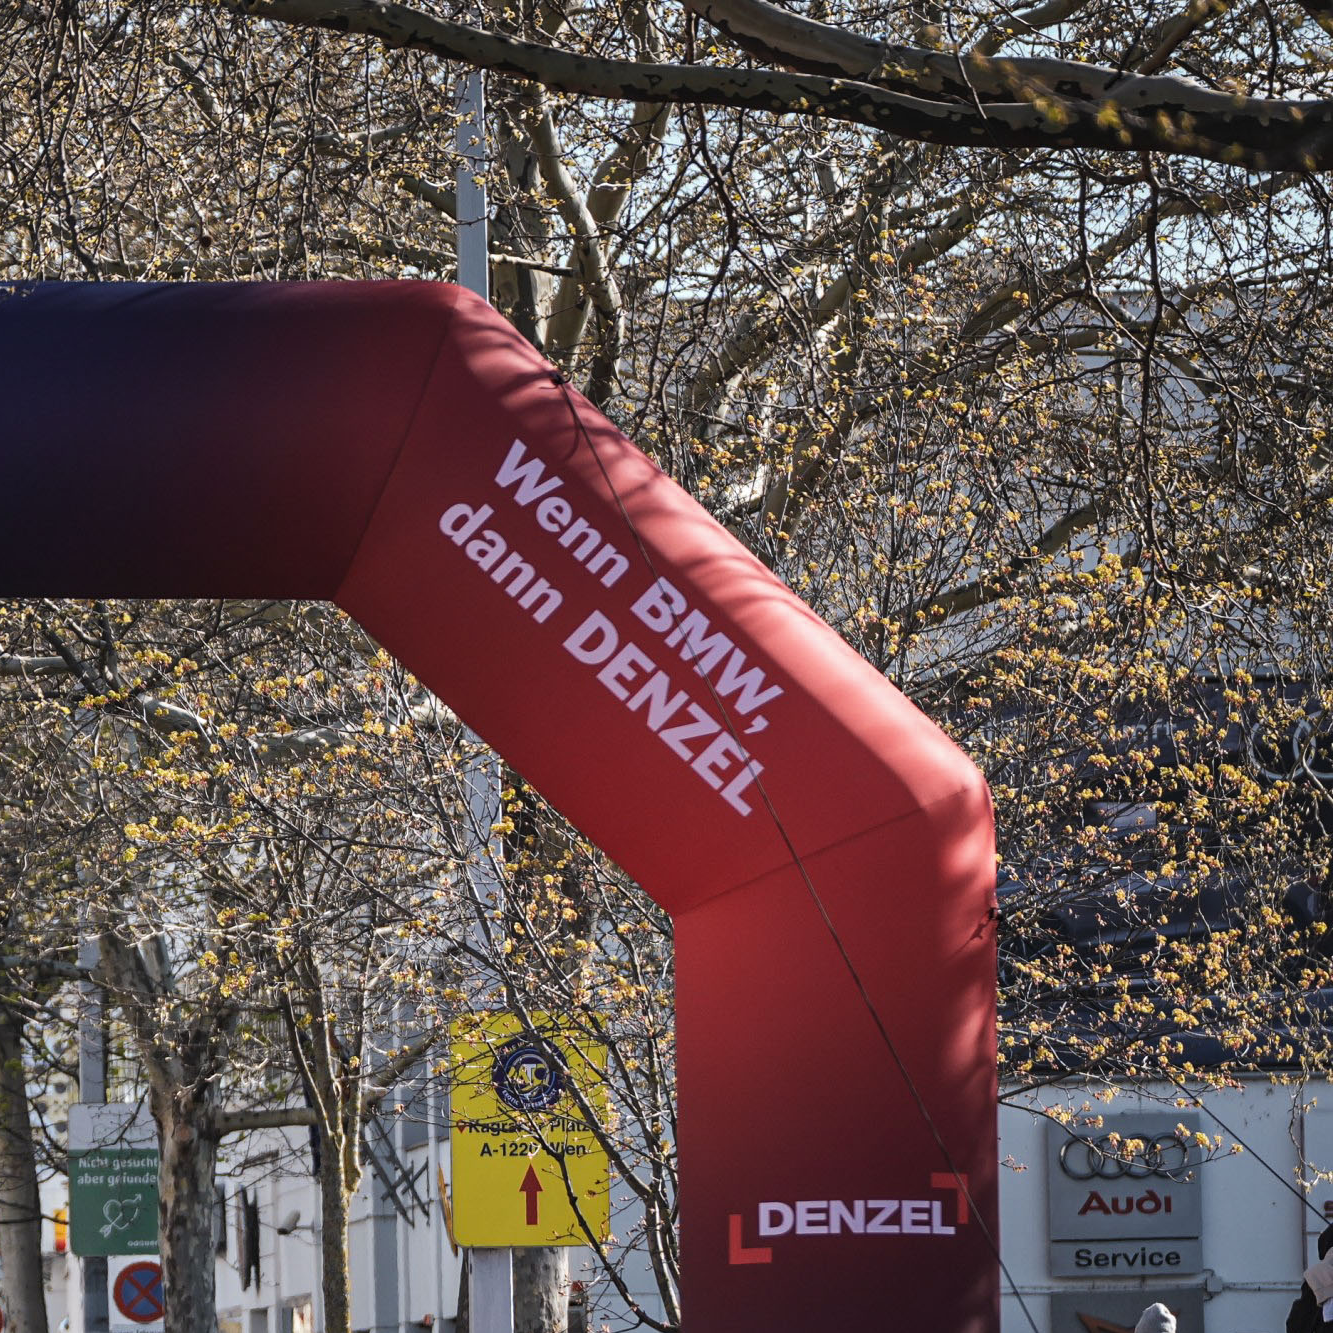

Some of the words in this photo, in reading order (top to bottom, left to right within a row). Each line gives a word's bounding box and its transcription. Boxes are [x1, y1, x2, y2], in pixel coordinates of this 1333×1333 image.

[493, 438, 631, 588] Wenn
[630, 576, 785, 735] BMW,
[439, 502, 564, 624] dann
[562, 609, 765, 817] DENZEL
[758, 1200, 956, 1237] DENZEL
[1077, 1190, 1173, 1216] Audi
[1074, 1247, 1182, 1269] Service
